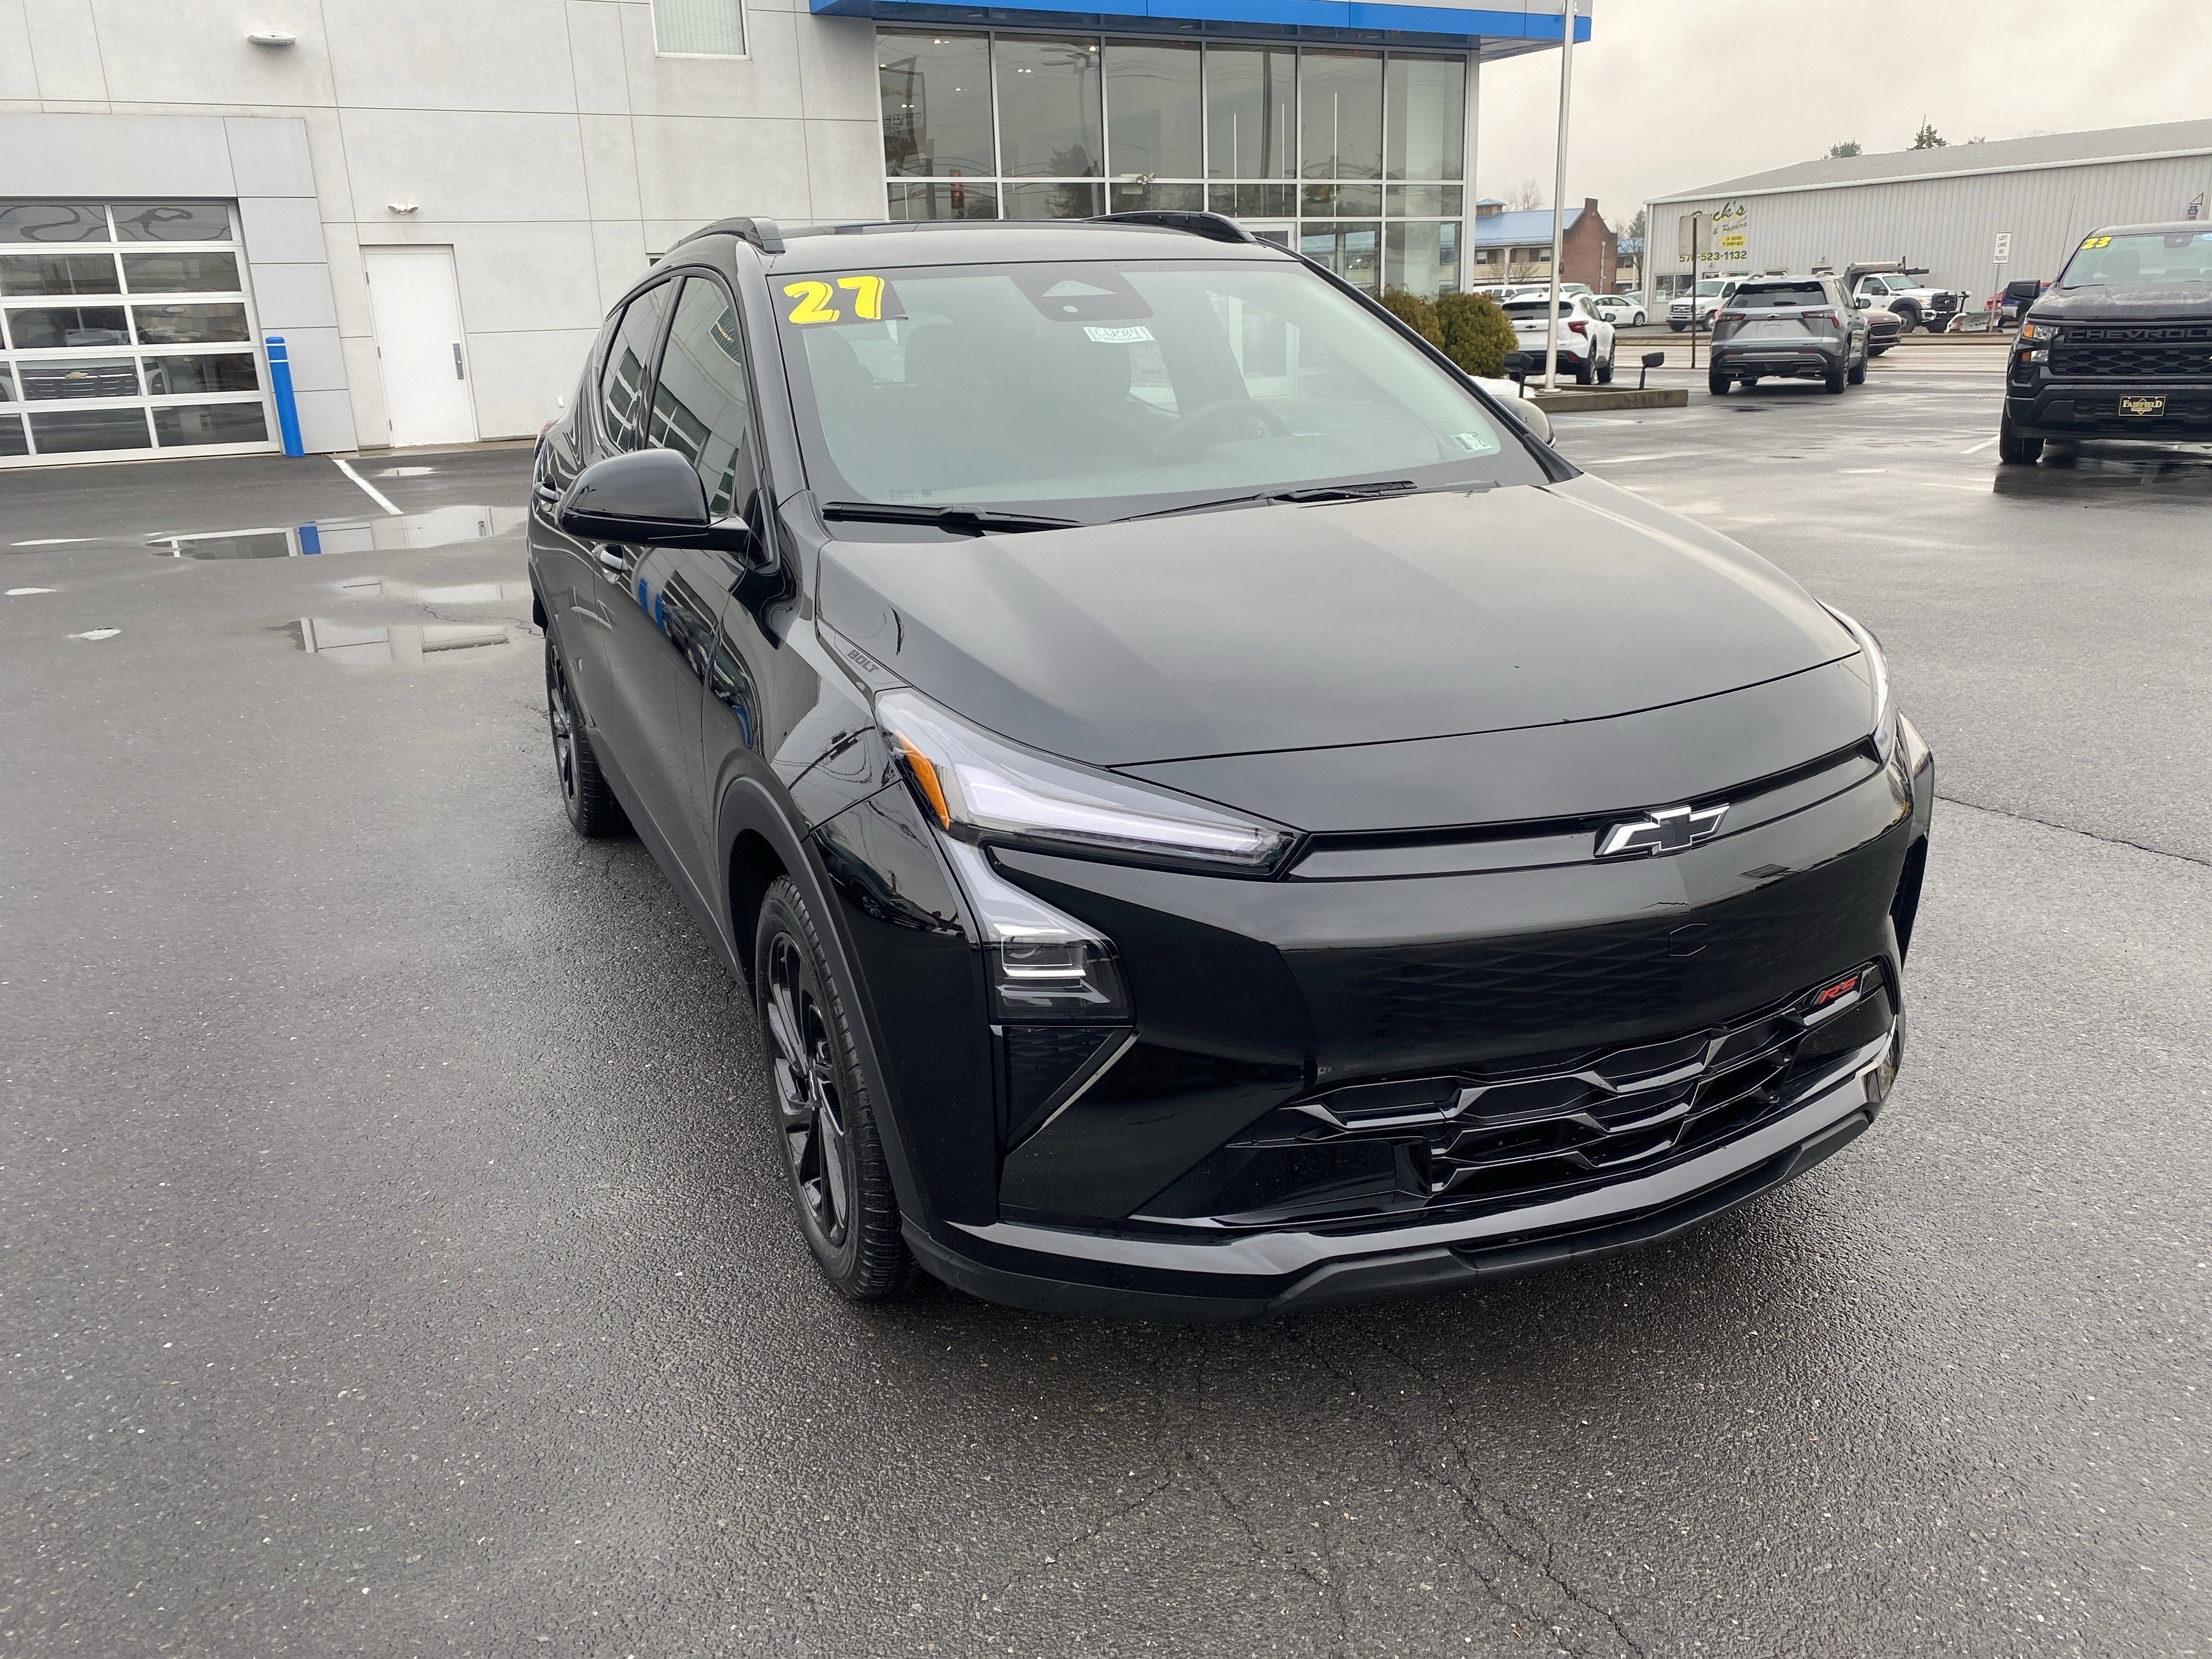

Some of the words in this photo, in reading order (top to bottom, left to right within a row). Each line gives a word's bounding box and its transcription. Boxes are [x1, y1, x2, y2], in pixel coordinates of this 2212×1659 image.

[2081, 236, 2112, 250] 23
[1679, 250, 1747, 262] 57-523-1132
[783, 276, 885, 324] 27
[847, 650, 879, 673] BOLT
[1815, 975, 1859, 1005] RS
